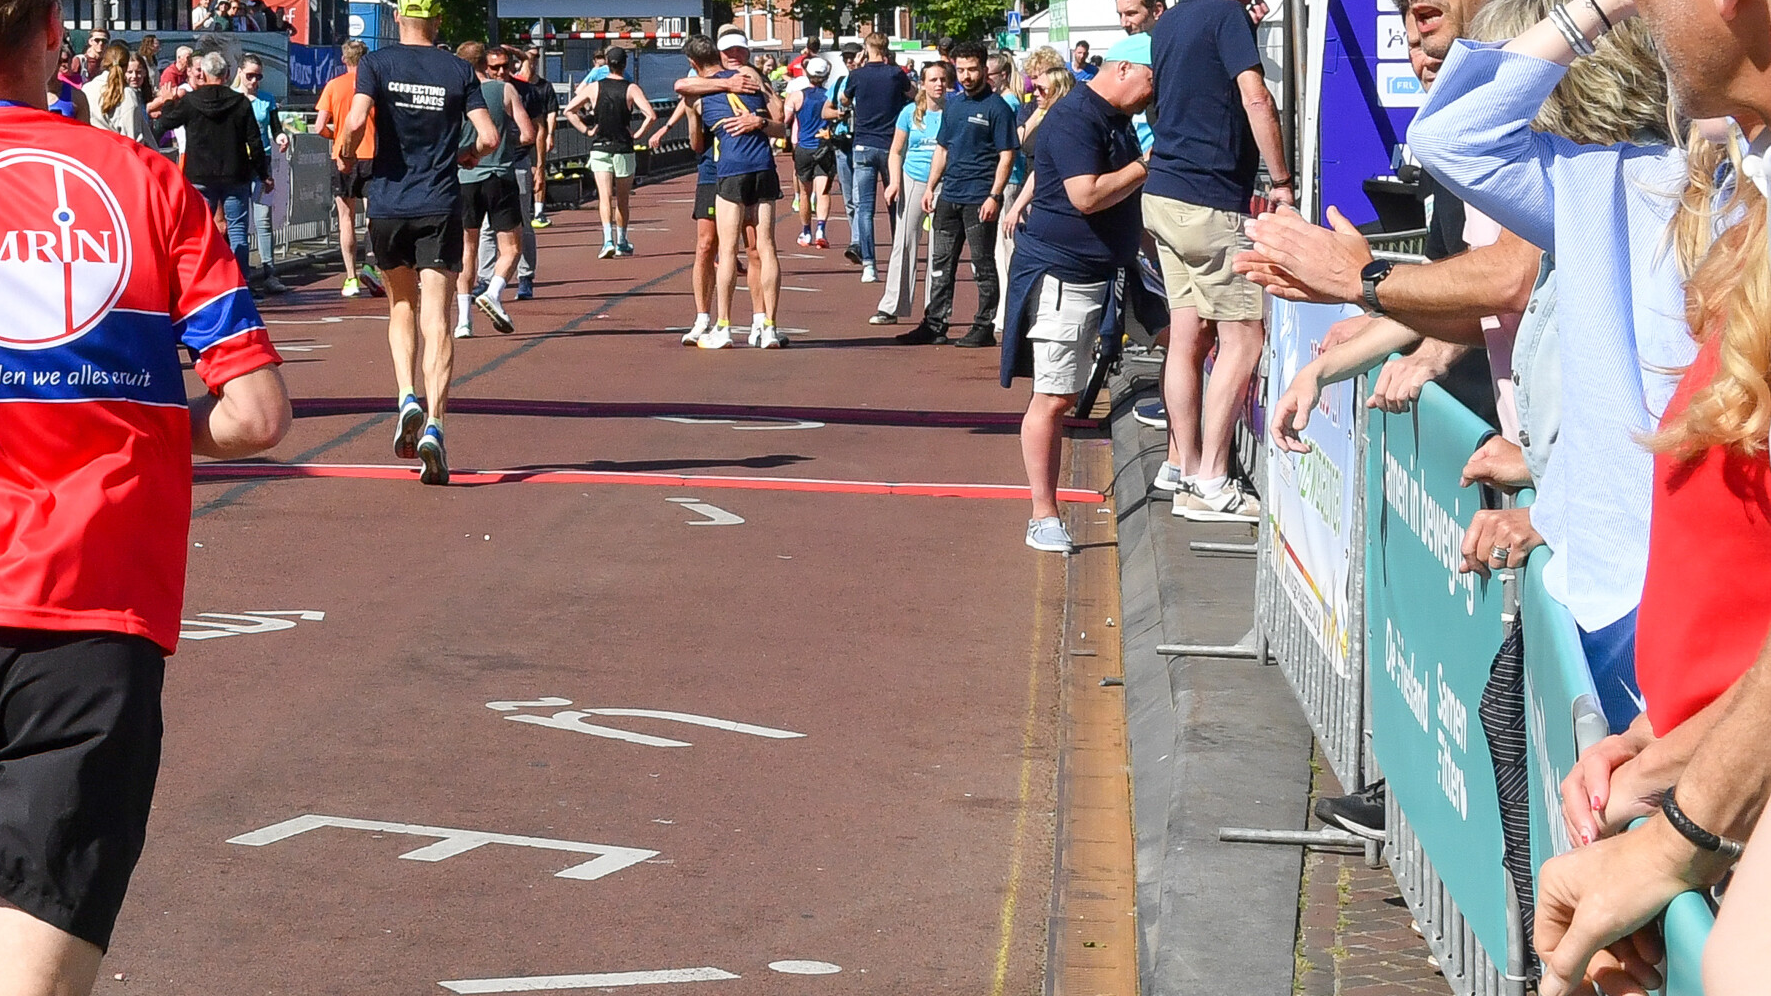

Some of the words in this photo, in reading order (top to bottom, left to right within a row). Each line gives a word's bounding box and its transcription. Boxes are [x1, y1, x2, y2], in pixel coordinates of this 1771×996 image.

[412, 94, 445, 107] HANDS
[32, 370, 61, 386] we
[67, 364, 109, 386] alles
